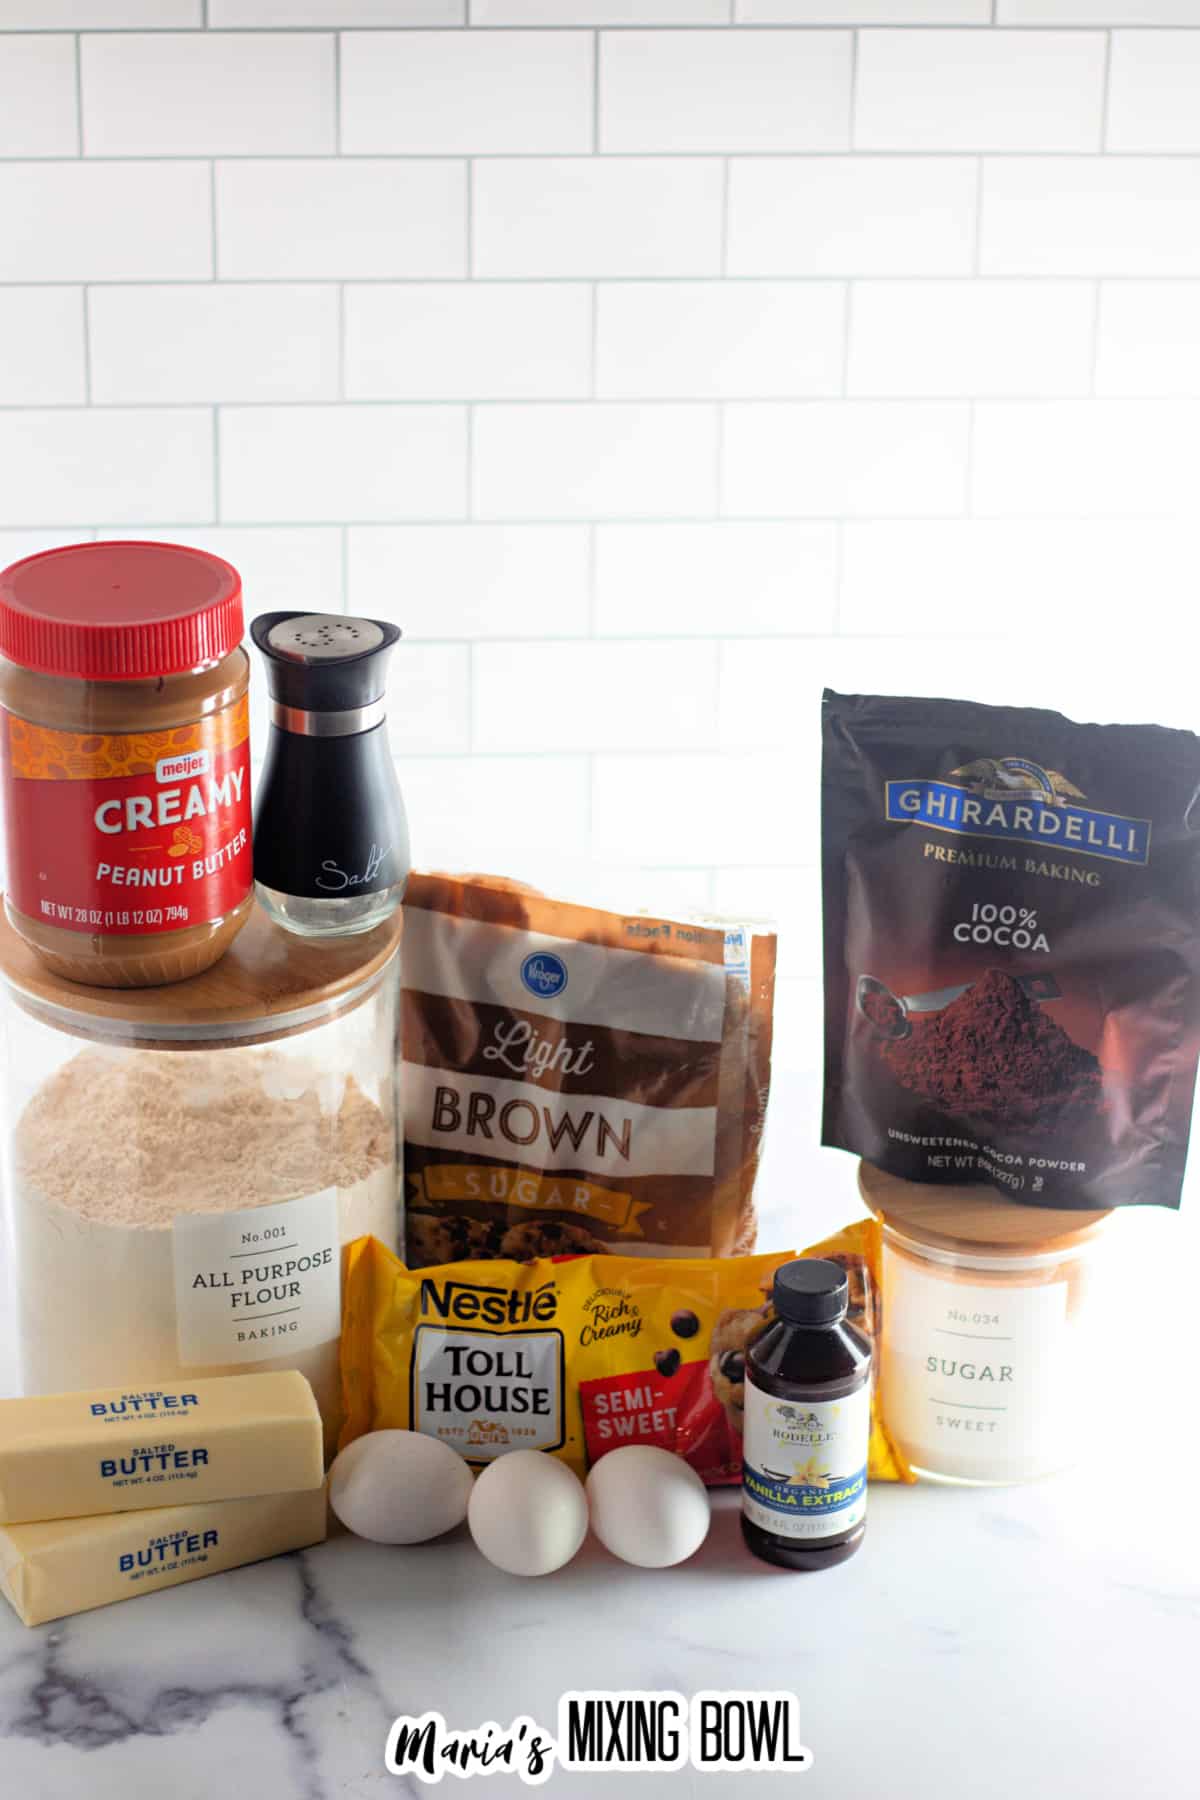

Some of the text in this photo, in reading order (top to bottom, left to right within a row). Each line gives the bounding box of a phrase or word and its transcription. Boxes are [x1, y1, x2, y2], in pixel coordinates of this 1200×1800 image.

[162, 755, 203, 777] meijer
[94, 767, 244, 834] CREAMY
[898, 790, 1136, 852] GHIRARDELLI
[96, 828, 247, 887] PEANUT BUTTER
[315, 844, 394, 890] Salt
[923, 842, 1101, 887] PREMIUM BAKING
[40, 899, 56, 916] NET
[57, 904, 73, 920] WT
[75, 908, 87, 923] 28
[89, 911, 102, 924] OZ
[117, 911, 129, 925] LB
[132, 911, 144, 925] 12
[146, 909, 163, 925] OZ)
[165, 904, 188, 921] 794g
[971, 903, 1038, 930] 100%
[953, 923, 1050, 953] COCOA
[528, 958, 561, 989] Kroger
[483, 1021, 595, 1079] Light
[431, 1086, 633, 1161] BROWN
[888, 1127, 1086, 1173] UNSWEETENED COCOA POWDER
[927, 1155, 952, 1168] NET
[955, 1156, 973, 1168] WT
[464, 1171, 590, 1210] SUGAR
[241, 1226, 287, 1244] No.001
[192, 1247, 333, 1289] ALL PURPOSE
[231, 1281, 301, 1308] FLOUR
[420, 1279, 558, 1325] Nestlé
[592, 1300, 630, 1326] Rich
[947, 1309, 1000, 1325] No.034
[237, 1321, 298, 1342] BAKING
[580, 1318, 644, 1346] Creamy
[444, 1346, 533, 1379] TOLL
[927, 1356, 1013, 1382] SUGAR
[90, 1394, 198, 1416] BUTTER
[425, 1382, 551, 1415] HOUSE
[593, 1386, 665, 1414] SEMI-
[597, 1407, 678, 1439] SWEET
[772, 1428, 834, 1443] RODELLE
[936, 1415, 998, 1433] SWEET
[101, 1449, 209, 1477] BUTTER
[132, 1444, 175, 1456] SALTED
[745, 1475, 798, 1506] VANILLA
[803, 1478, 864, 1506] EXTRACT
[774, 1485, 830, 1495] ORGANIC
[119, 1530, 218, 1572] BUTTER
[149, 1530, 188, 1546] SALTED
